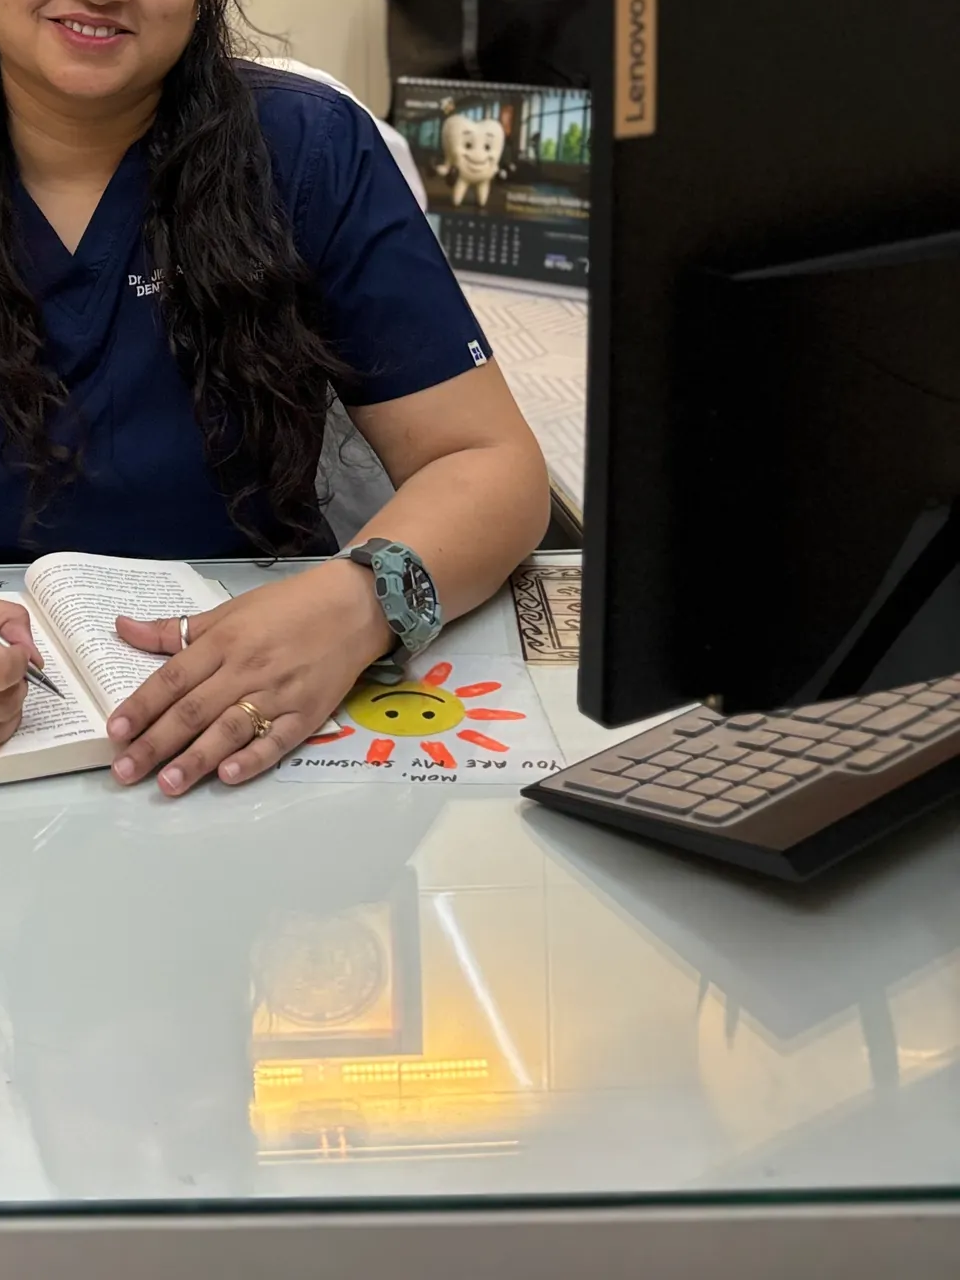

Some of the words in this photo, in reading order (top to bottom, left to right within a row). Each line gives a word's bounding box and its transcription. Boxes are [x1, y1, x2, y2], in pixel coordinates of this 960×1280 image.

[127, 274, 145, 286] Dr.
[411, 758, 445, 769] MY
[465, 759, 507, 768] ARE
[521, 759, 561, 771] YOU
